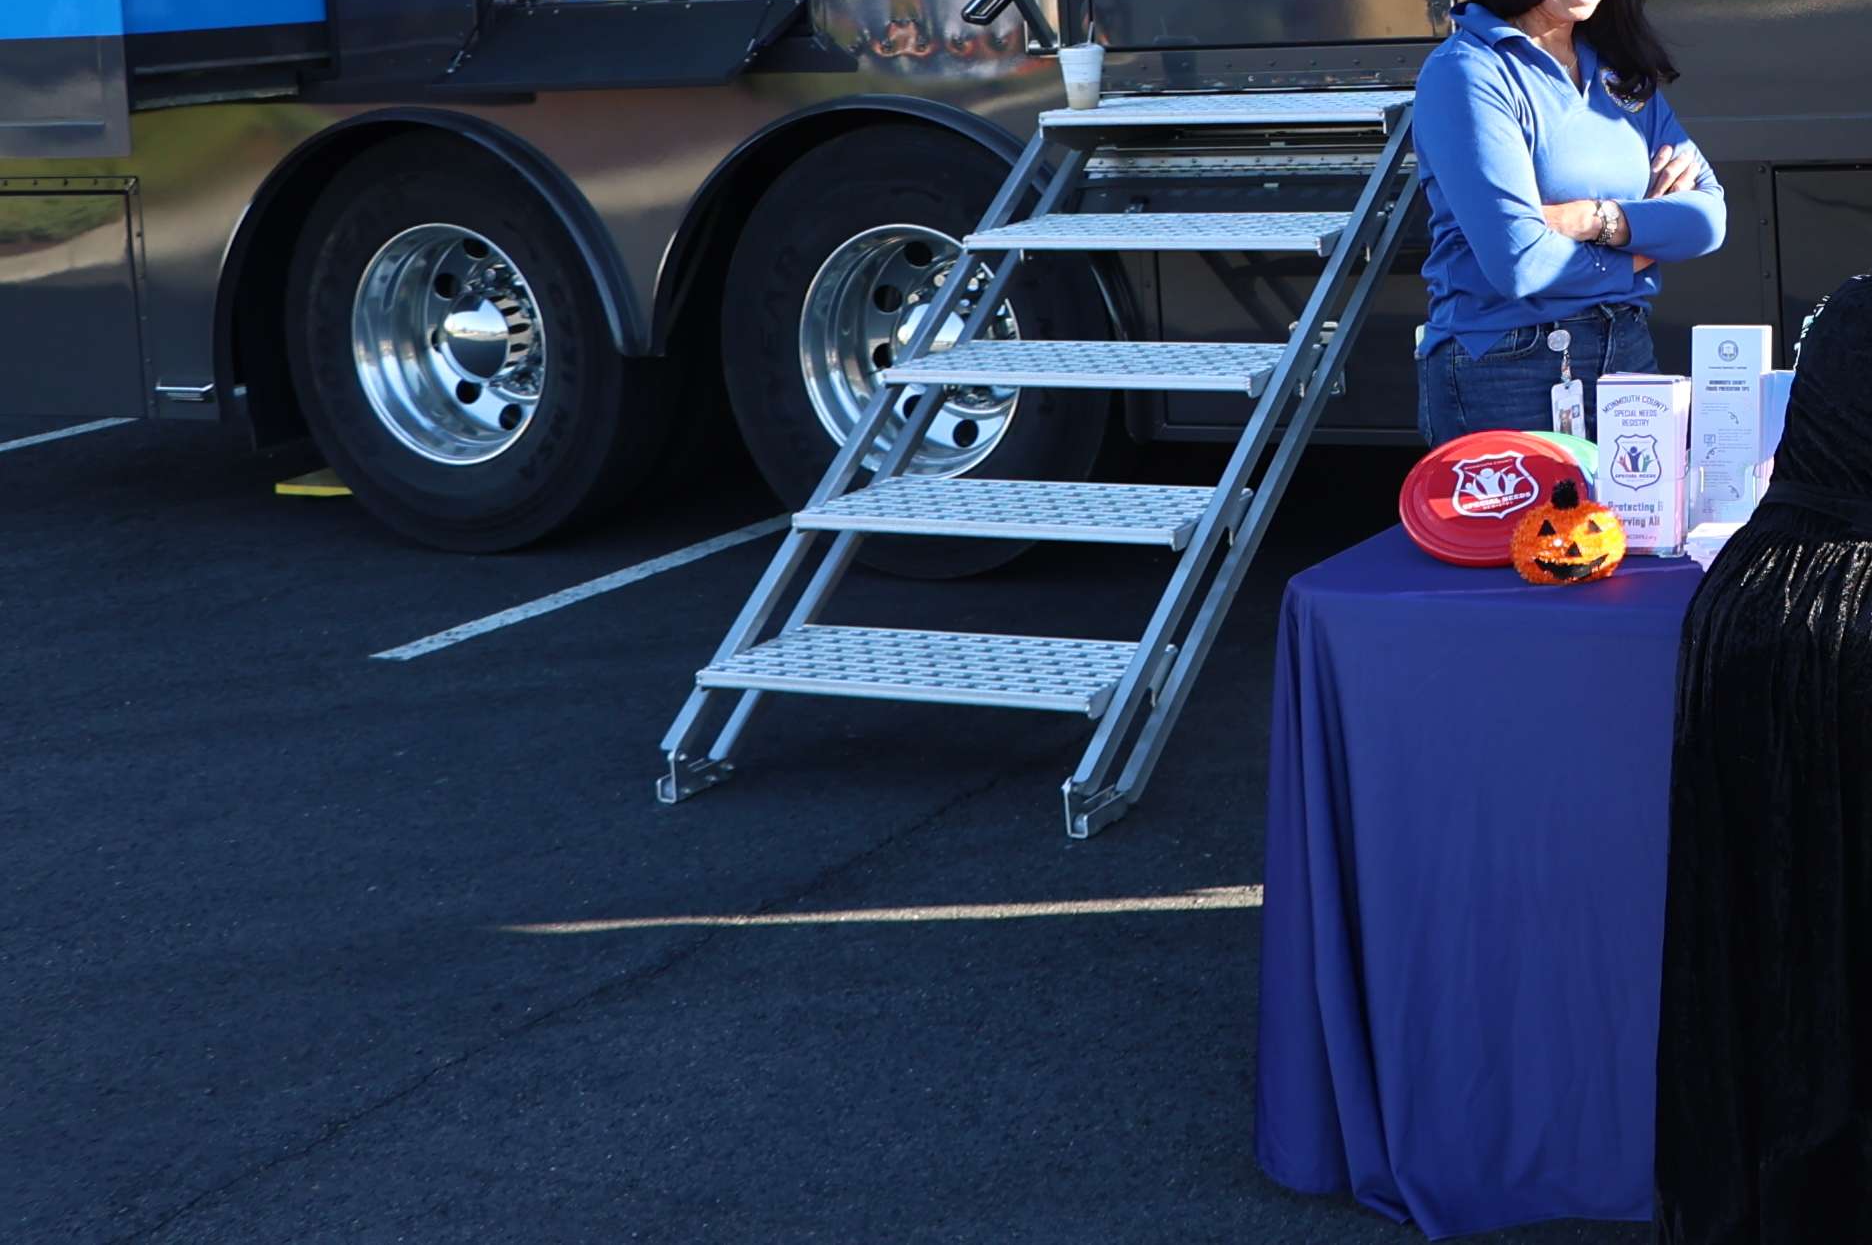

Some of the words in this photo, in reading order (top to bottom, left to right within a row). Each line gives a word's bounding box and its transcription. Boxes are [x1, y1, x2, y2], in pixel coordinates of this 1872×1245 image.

[1602, 395, 1640, 413] MONMOUTH
[1642, 395, 1669, 413] COUNTY
[1614, 409, 1636, 417] SPECIAL
[1638, 409, 1657, 417] NEEDS
[1501, 492, 1531, 503] NEEDS
[1608, 501, 1655, 513] Protecting
